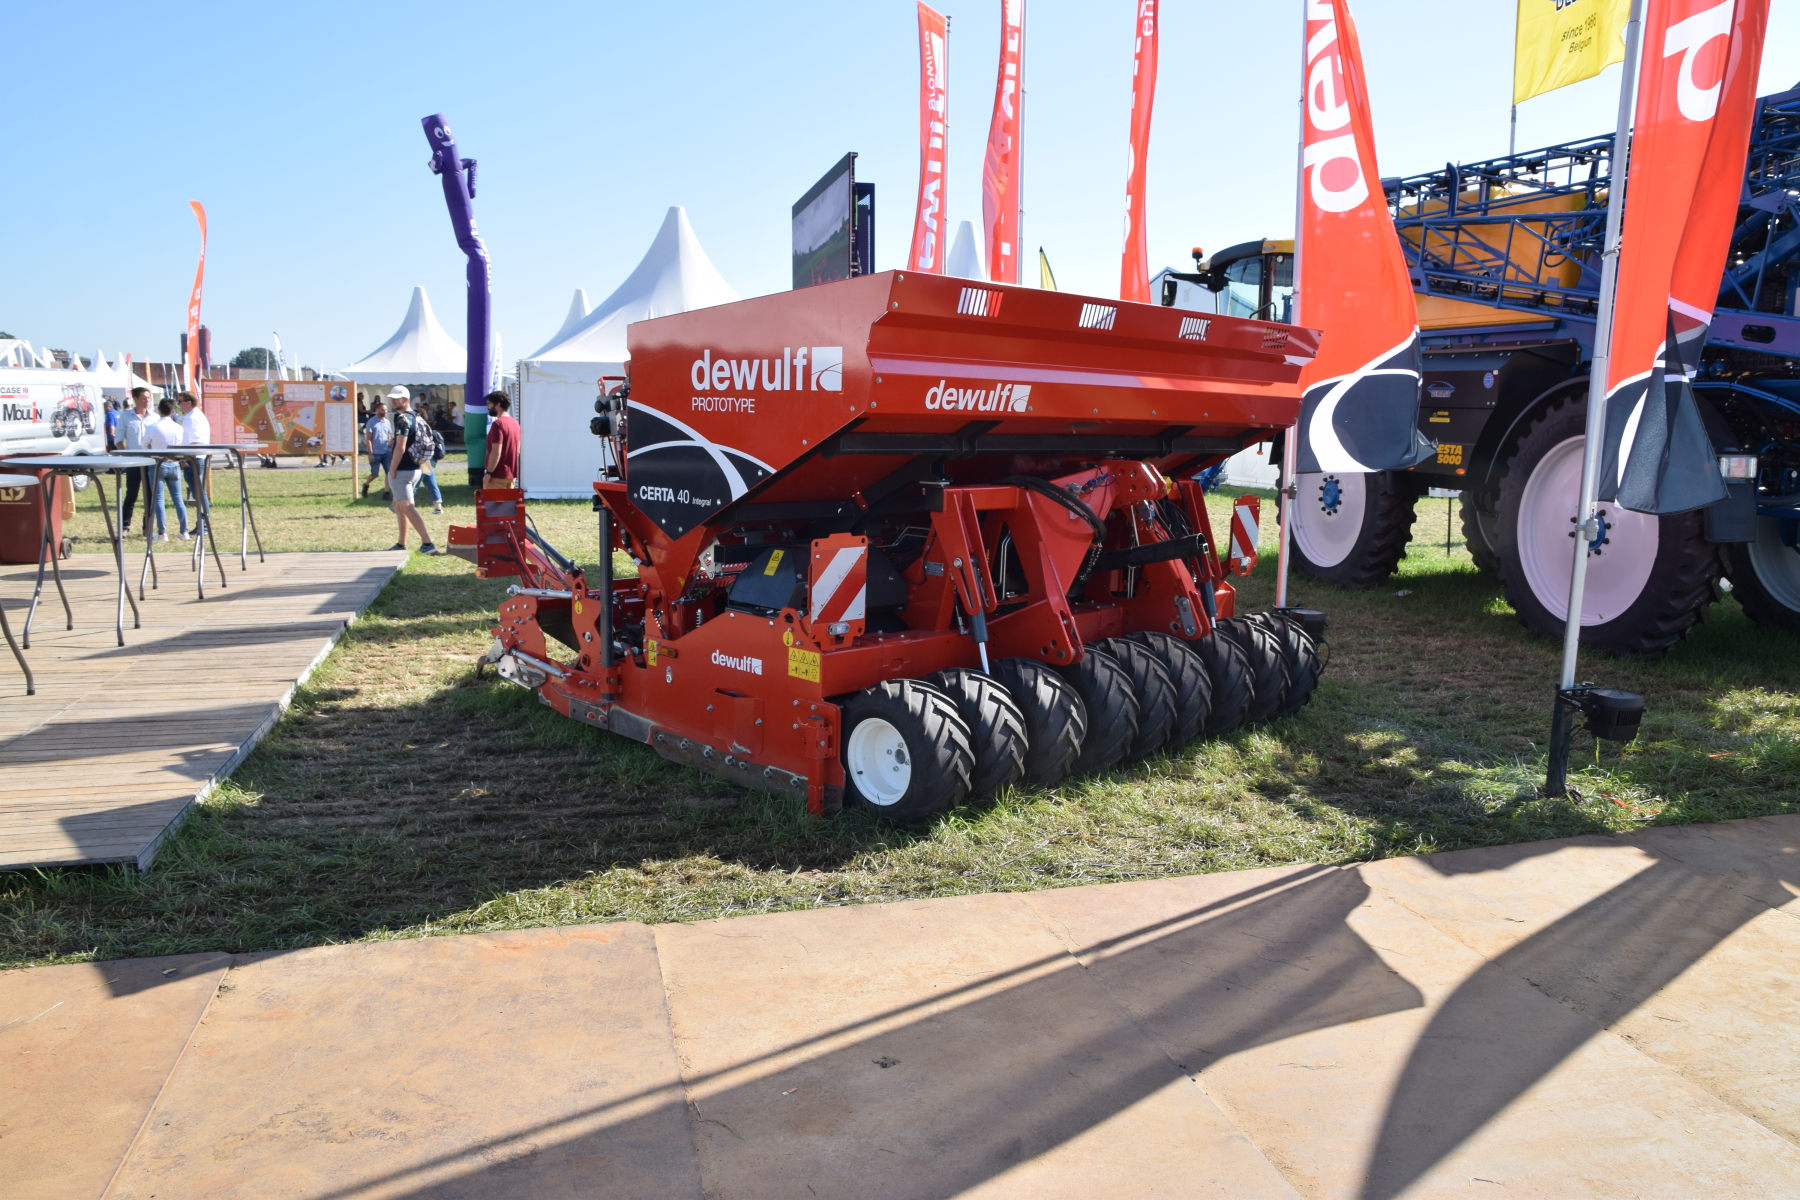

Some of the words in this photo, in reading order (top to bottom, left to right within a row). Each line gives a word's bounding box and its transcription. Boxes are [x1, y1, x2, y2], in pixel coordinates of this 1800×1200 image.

[1561, 24, 1584, 42] since
[1568, 36, 1592, 53] Belgium
[691, 346, 808, 391] dewulf
[925, 379, 1013, 412] dewulf
[691, 397, 756, 413] PROTOTYPE
[1437, 454, 1462, 465] 5000
[640, 485, 675, 502] CERTA
[677, 489, 690, 504] 40
[711, 649, 752, 673] dewulf
